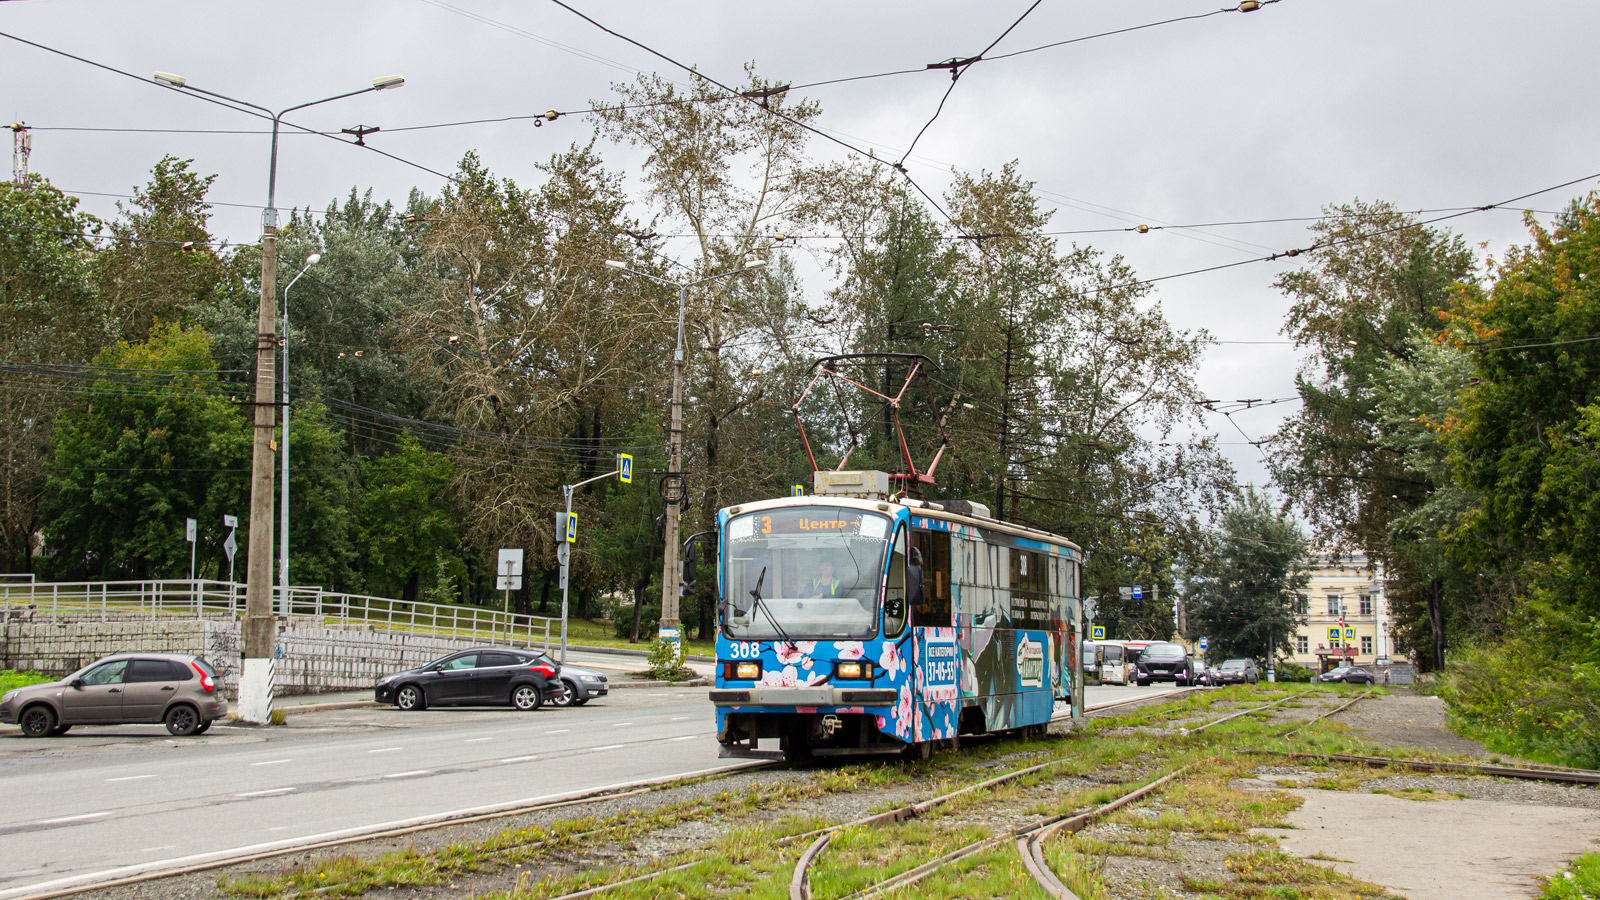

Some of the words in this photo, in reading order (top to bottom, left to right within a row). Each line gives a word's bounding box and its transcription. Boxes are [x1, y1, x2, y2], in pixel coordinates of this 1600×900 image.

[761, 516, 772, 534] 3
[800, 518, 847, 531] Центр
[730, 642, 760, 659] 308
[928, 661, 954, 682] 37-05-55
